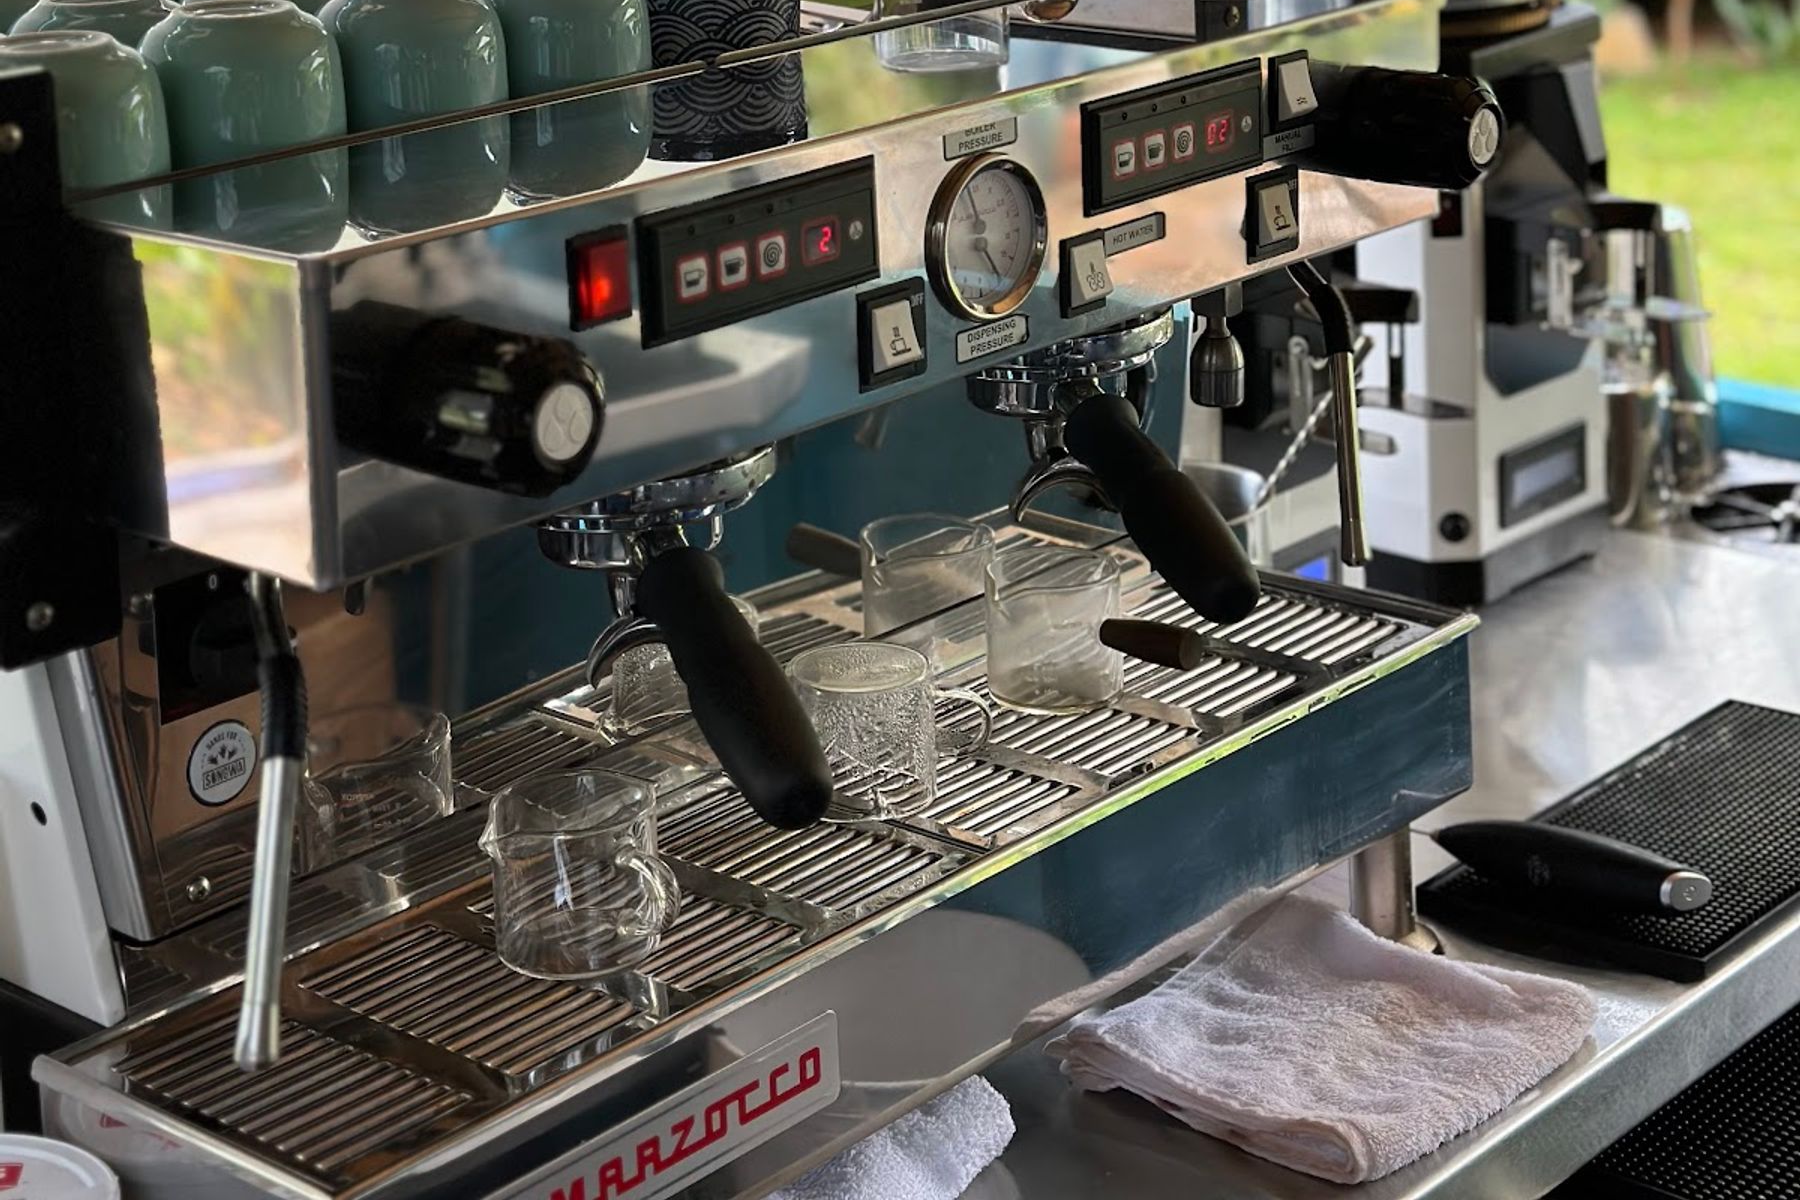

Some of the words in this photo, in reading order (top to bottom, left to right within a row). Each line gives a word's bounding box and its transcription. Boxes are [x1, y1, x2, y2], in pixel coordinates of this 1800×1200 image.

[958, 132, 1004, 152] PRESSURE
[1207, 119, 1228, 145] 02
[818, 226, 832, 252] 2
[1112, 233, 1128, 245] HOT
[1128, 224, 1154, 240] WATER
[967, 319, 1016, 343] DISPENSING
[970, 332, 1015, 355] PRESSURE
